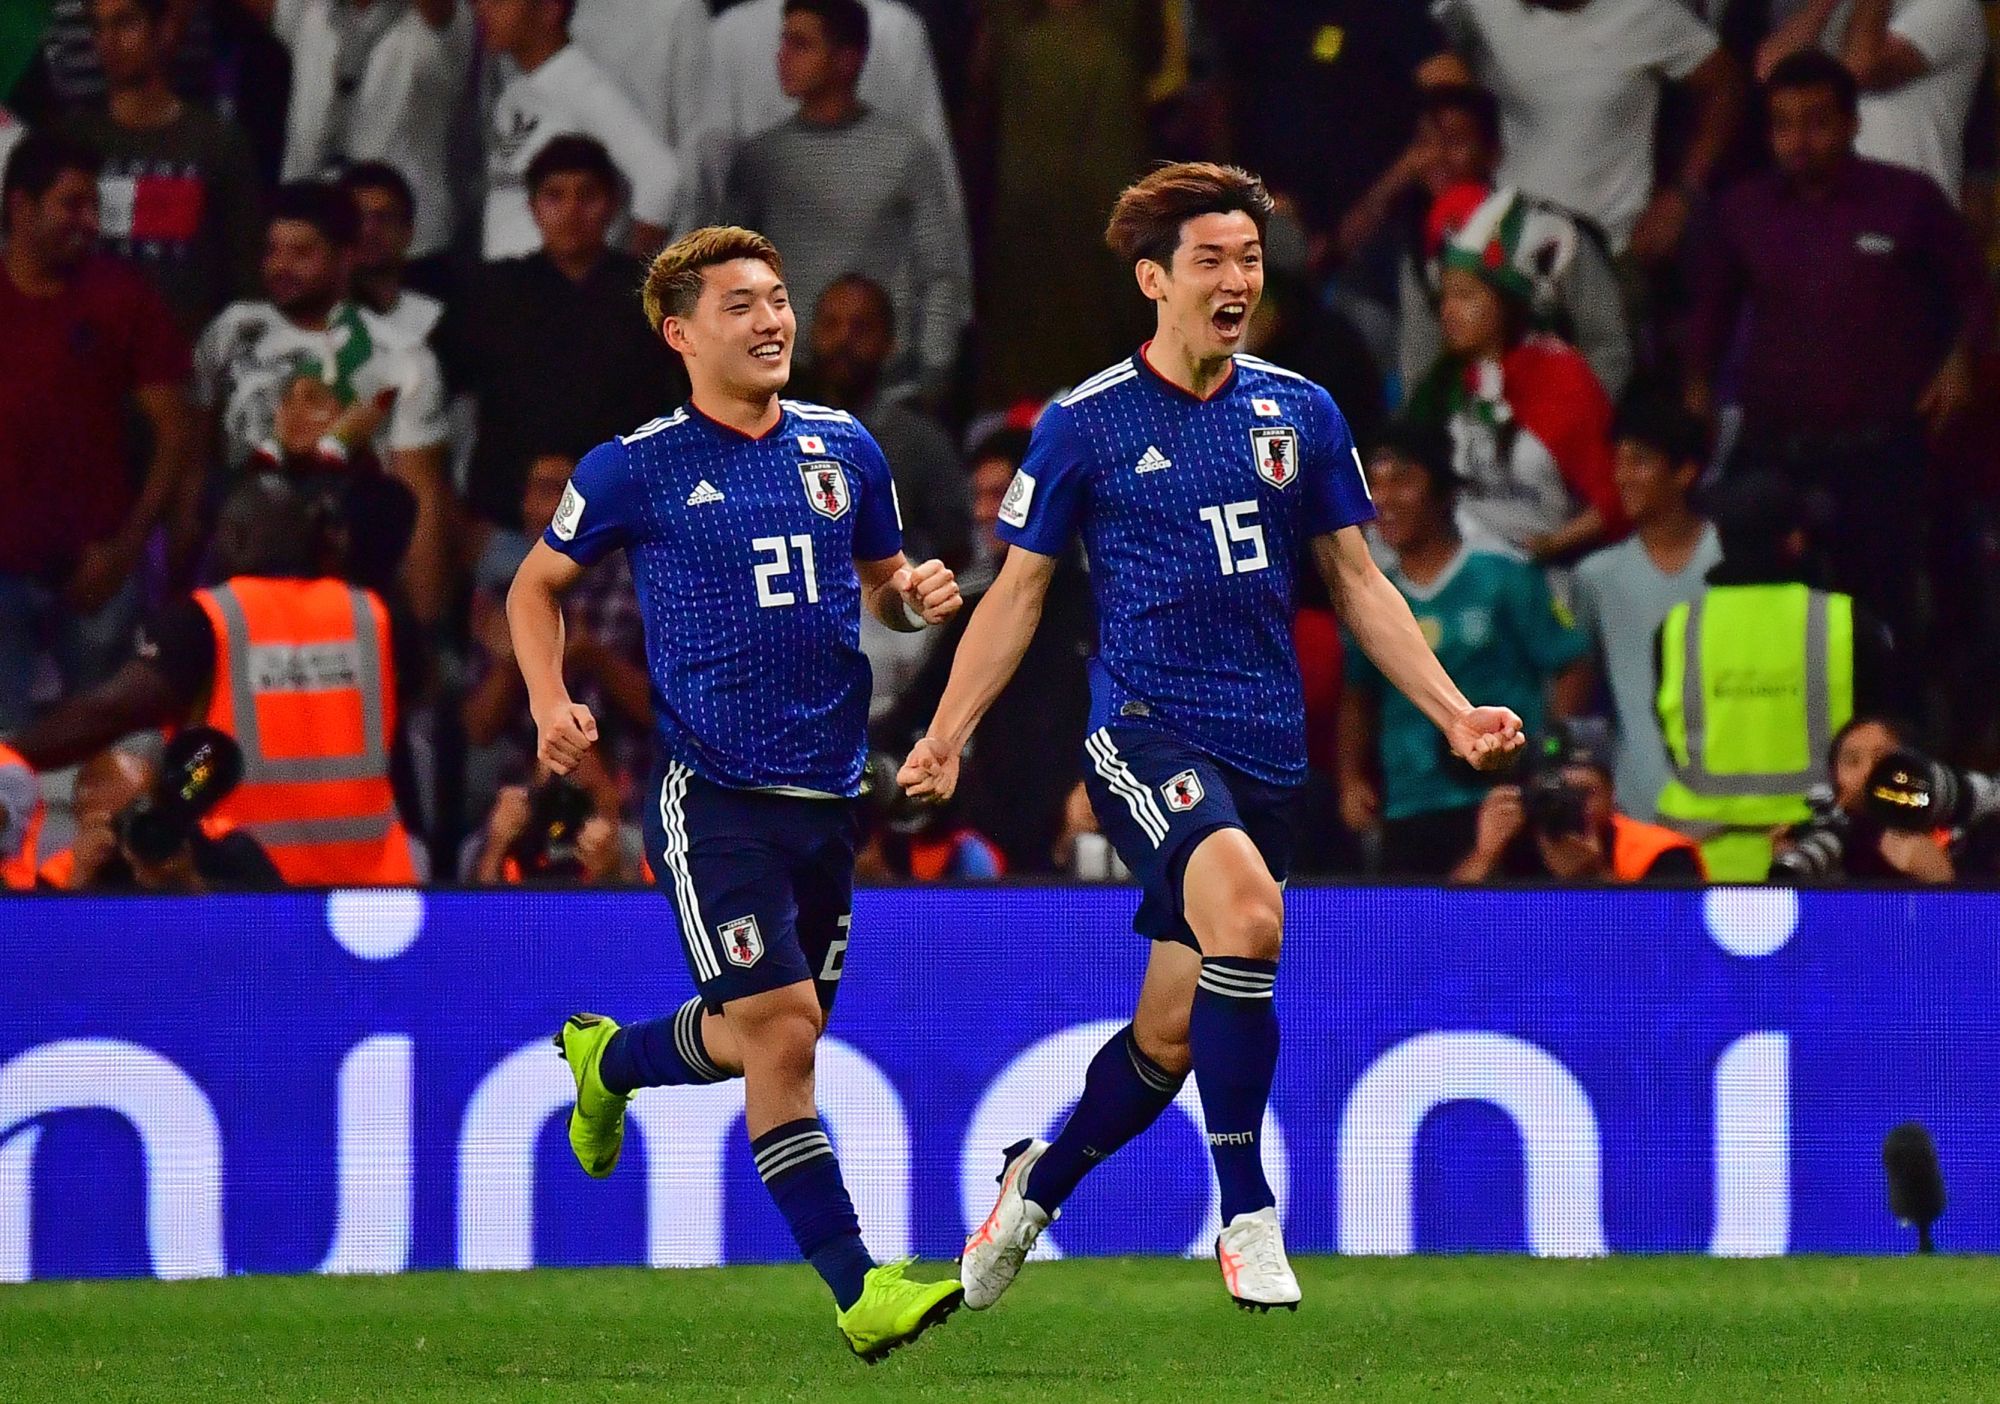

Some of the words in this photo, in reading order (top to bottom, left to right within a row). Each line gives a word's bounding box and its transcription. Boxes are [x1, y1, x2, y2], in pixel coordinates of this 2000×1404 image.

[686, 492, 725, 506] adidas
[1135, 459, 1172, 474] adidas
[752, 534, 819, 608] 21
[1199, 500, 1269, 576] 15
[818, 914, 852, 981] 2
